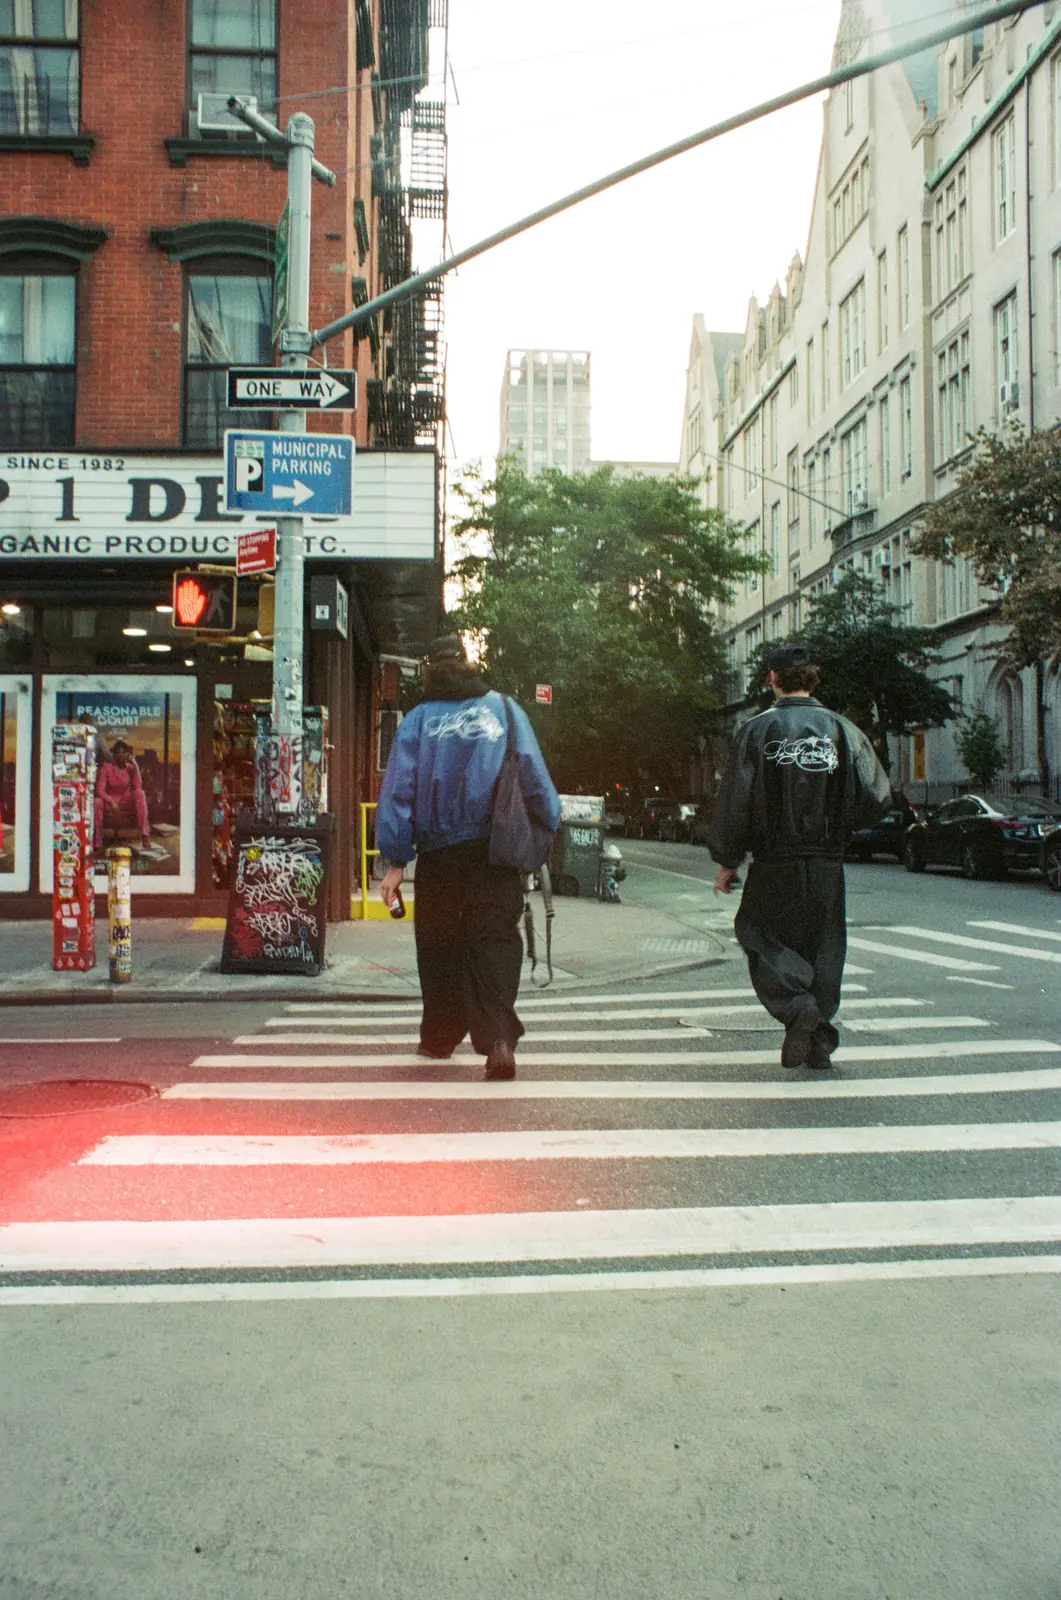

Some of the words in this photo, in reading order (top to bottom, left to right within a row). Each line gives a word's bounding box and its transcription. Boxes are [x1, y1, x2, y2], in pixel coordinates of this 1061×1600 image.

[246, 381, 282, 396] ONE
[300, 382, 336, 397] WAY
[271, 440, 346, 460] MUNICIPAL
[7, 457, 69, 470] SINCE
[80, 458, 125, 471] 1982
[271, 458, 332, 476] PARKING
[0, 535, 91, 553] GANIC
[302, 535, 347, 553] TC.
[77, 706, 161, 717] REASONABLE
